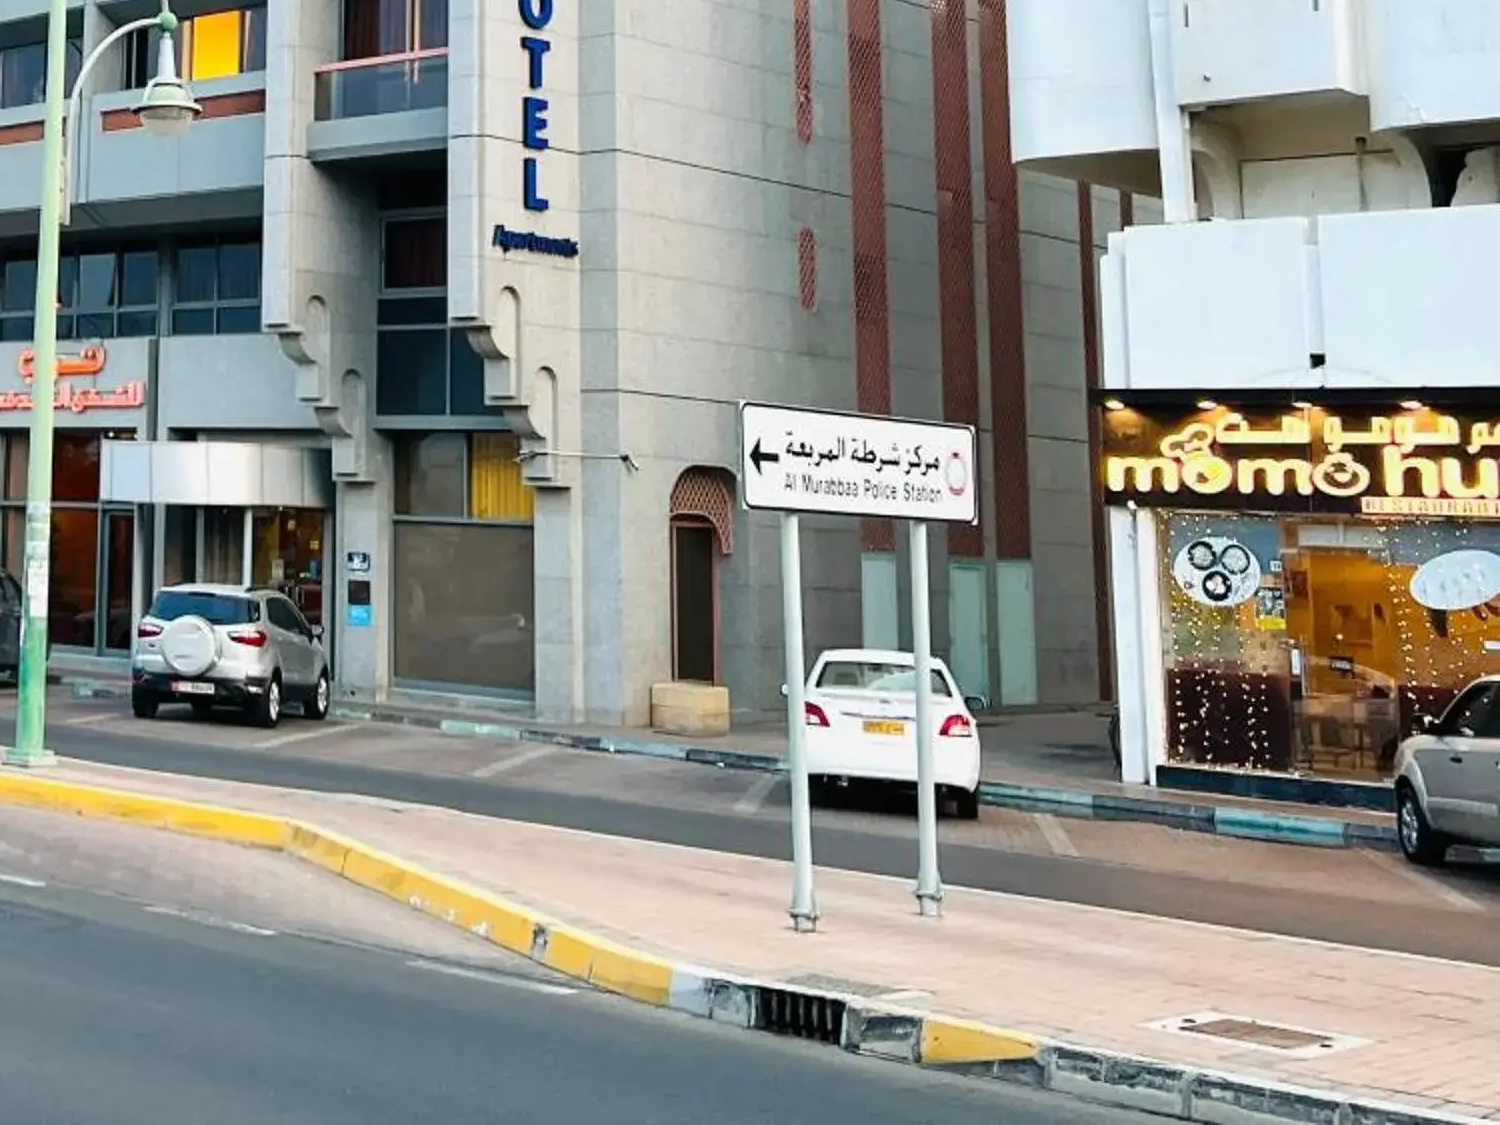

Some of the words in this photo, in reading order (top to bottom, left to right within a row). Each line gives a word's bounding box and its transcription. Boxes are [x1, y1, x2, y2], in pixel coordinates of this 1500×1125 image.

[785, 430, 847, 468] المربعة
[851, 438, 900, 473] شرطة
[905, 444, 940, 476] مركز
[784, 473, 797, 492] Al
[802, 474, 859, 499] Murabbaa
[863, 478, 897, 501] Police
[903, 482, 943, 504] Station
[1105, 452, 1370, 496] momo
[1383, 444, 1500, 499] hu
